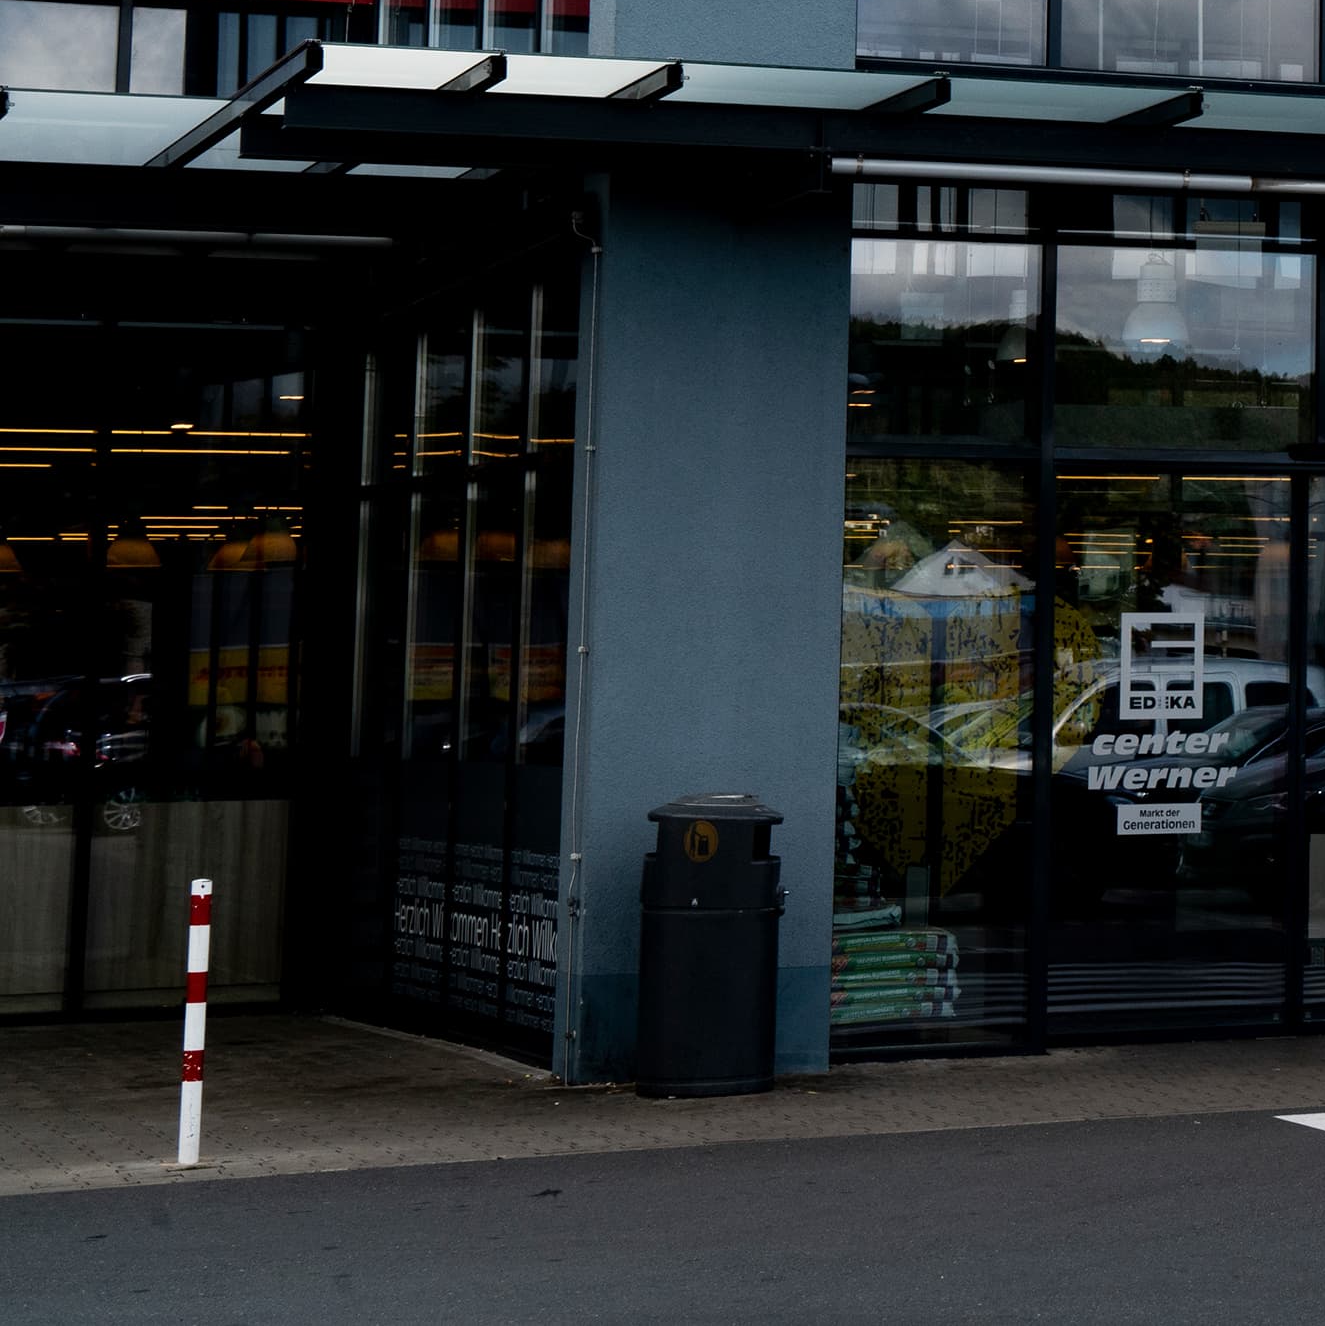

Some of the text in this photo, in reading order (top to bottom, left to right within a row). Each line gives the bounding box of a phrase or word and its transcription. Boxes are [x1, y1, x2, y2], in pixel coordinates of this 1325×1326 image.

[1092, 729, 1231, 756] center
[1087, 765, 1239, 791] Werner
[1139, 809, 1181, 818] Markt der
[1123, 819, 1196, 831] Generationen
